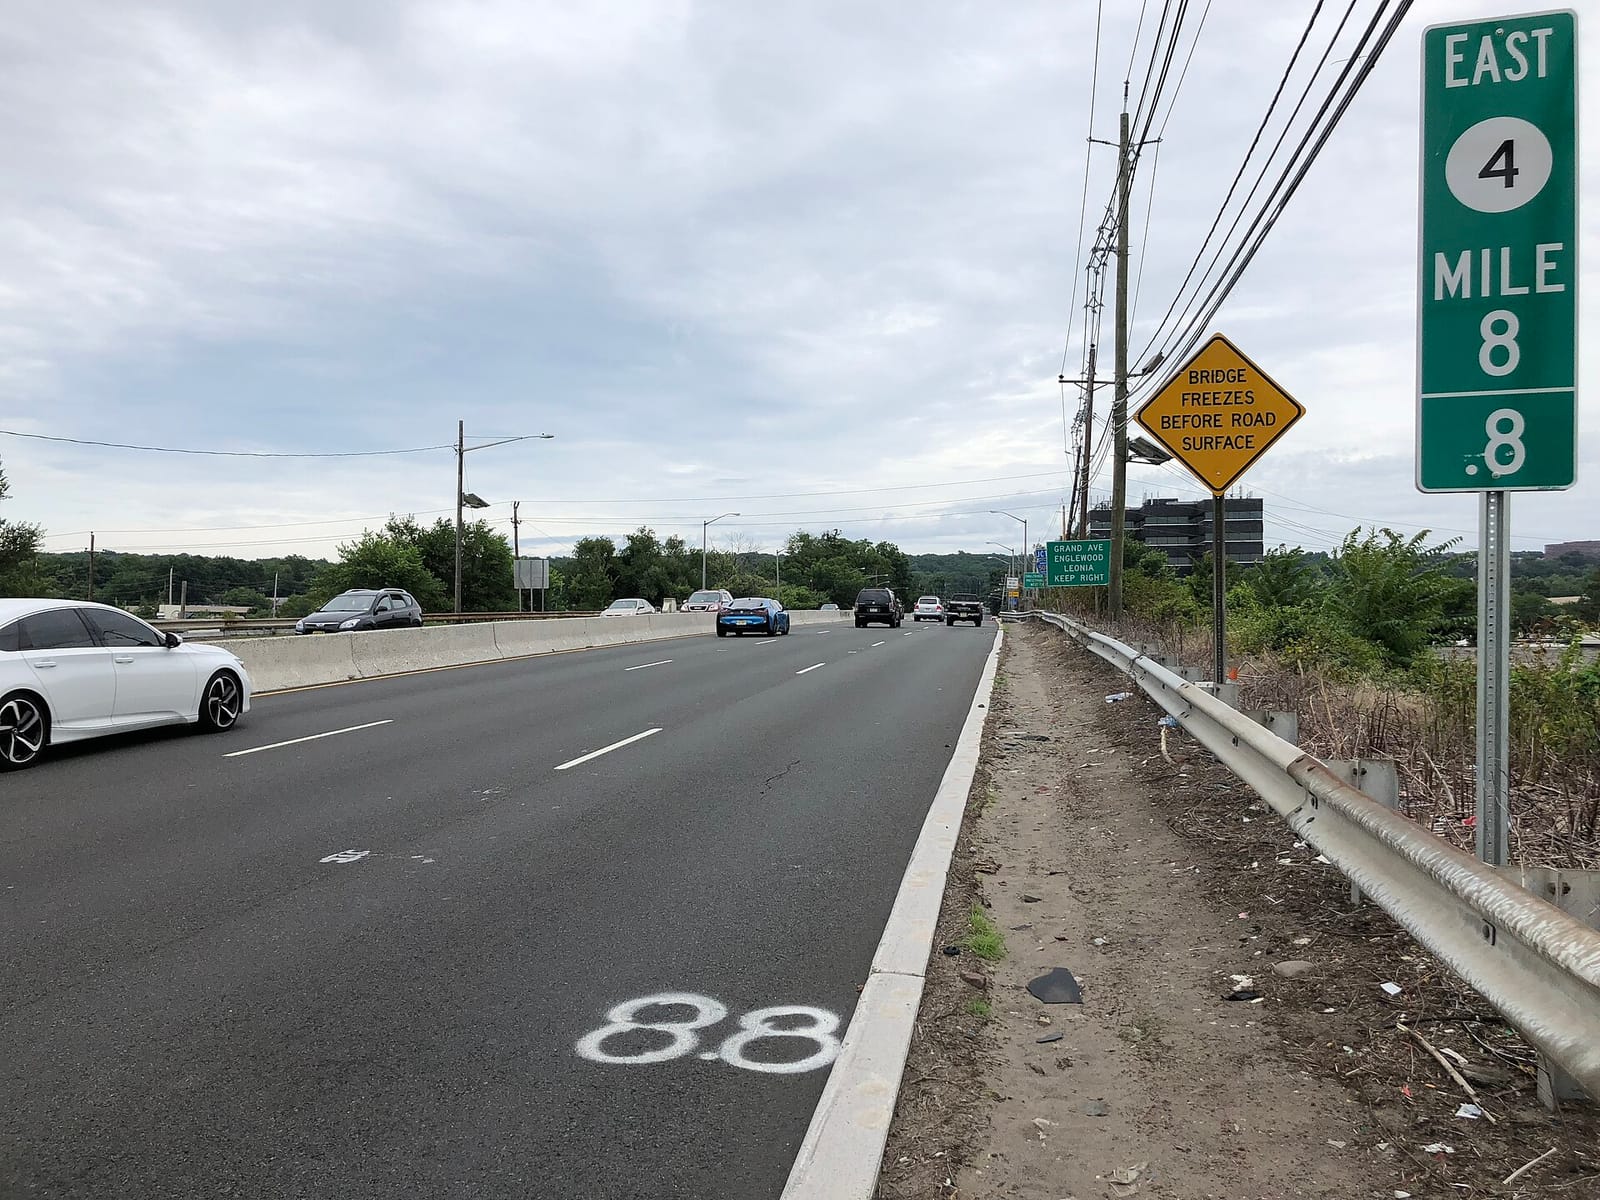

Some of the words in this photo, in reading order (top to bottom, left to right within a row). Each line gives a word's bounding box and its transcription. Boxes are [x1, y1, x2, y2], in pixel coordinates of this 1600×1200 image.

[1445, 27, 1553, 89] EAST
[1478, 139, 1519, 189] 4
[1434, 242, 1566, 301] MILE
[1478, 309, 1520, 378] 8
[1189, 368, 1247, 384] BRIDGE
[1181, 390, 1255, 406] FREEZES
[1161, 413, 1223, 429] BEFORE
[1231, 412, 1276, 427] ROAD
[1182, 435, 1255, 451] SURFACE
[1465, 408, 1526, 477] .8
[1053, 544, 1083, 552] GRAND
[1087, 543, 1104, 552] AVE
[1054, 554, 1104, 563] ENGLEWOOD
[1063, 564, 1094, 572] LEONIA
[1054, 574, 1075, 582] KEEP
[1080, 573, 1105, 582] RIGHT
[575, 992, 842, 1074] 8.8
